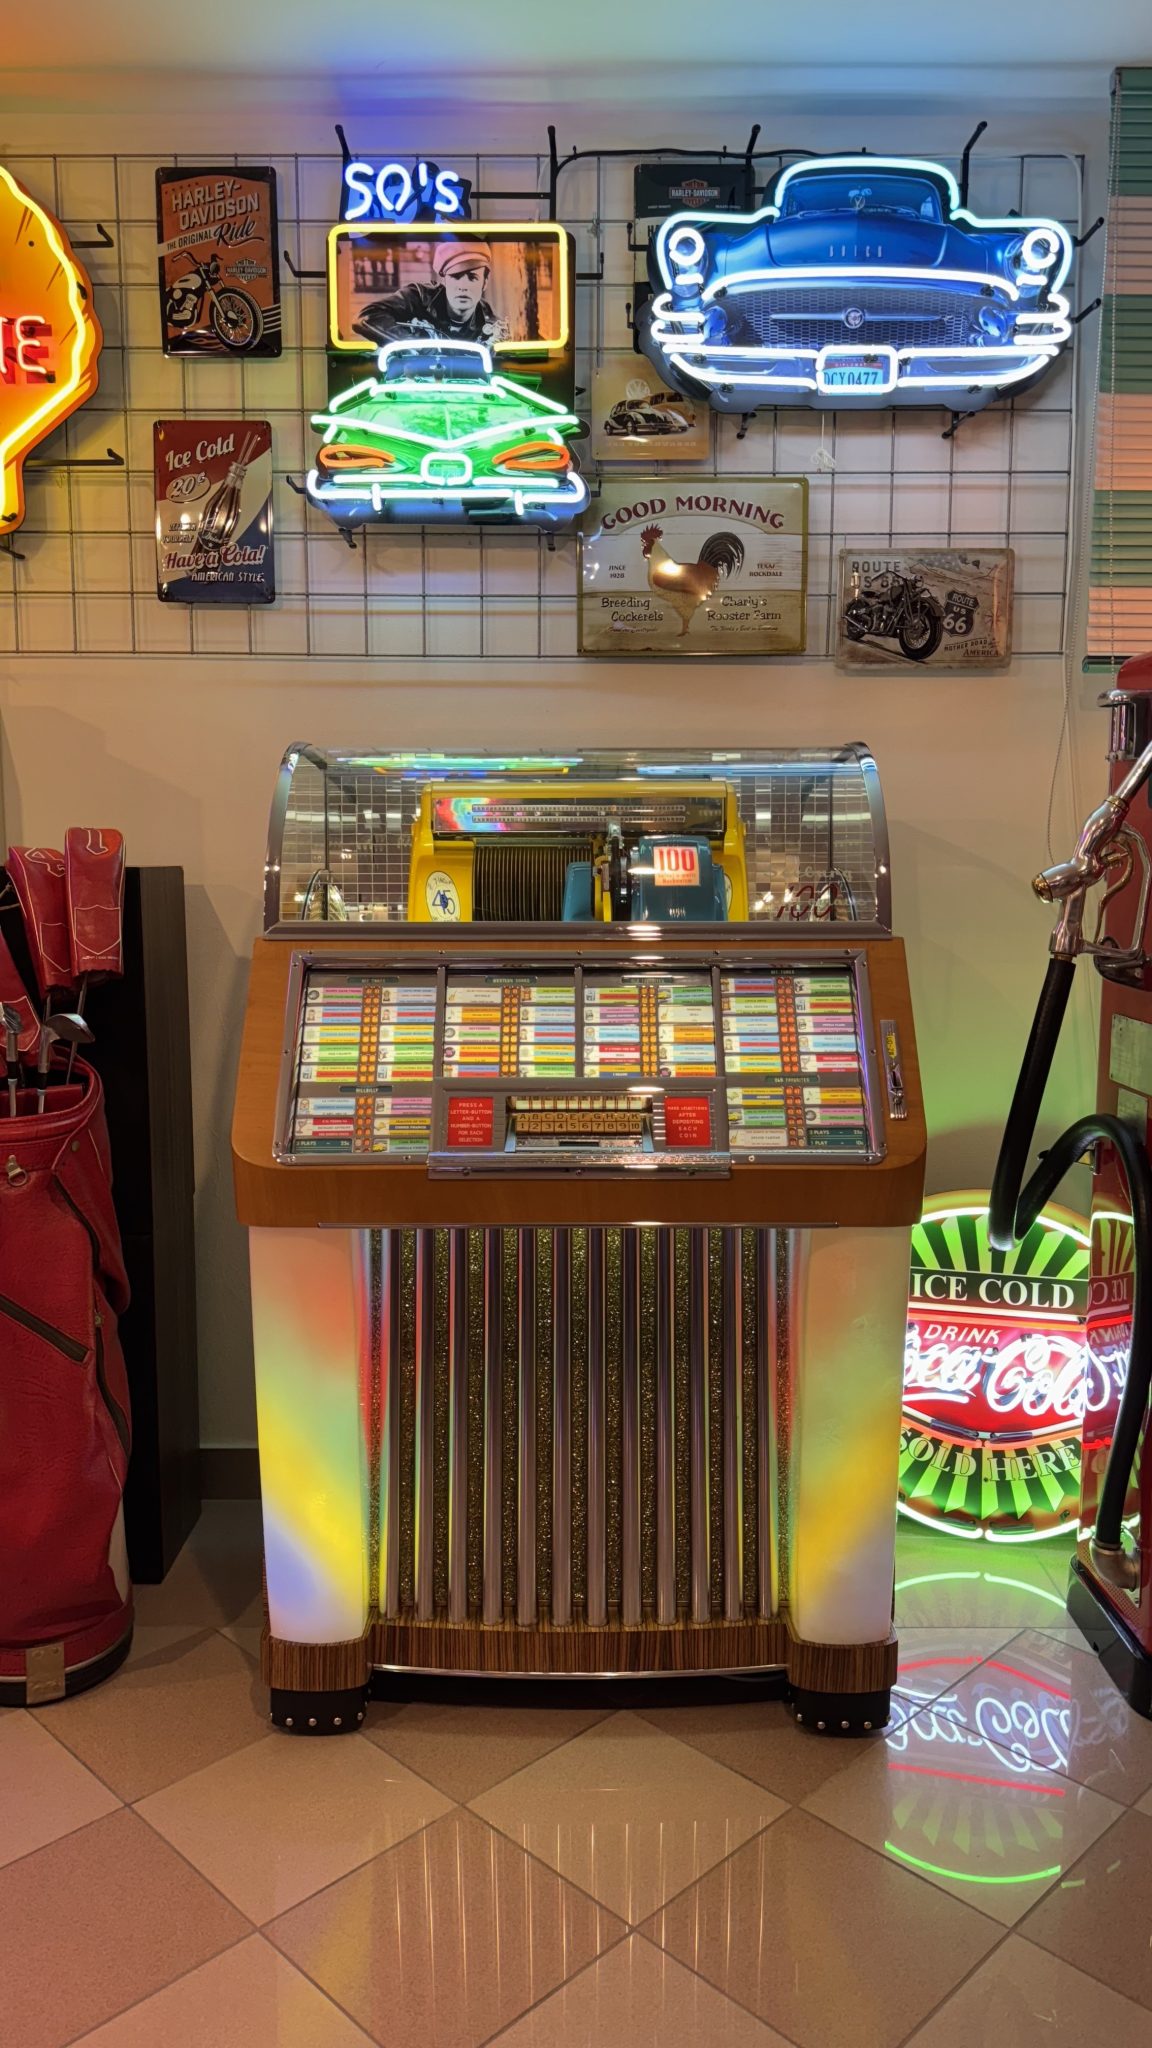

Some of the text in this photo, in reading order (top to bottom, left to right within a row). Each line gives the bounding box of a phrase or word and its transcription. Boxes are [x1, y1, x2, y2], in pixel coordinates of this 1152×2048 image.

[172, 179, 242, 212] HARLEY-
[180, 192, 260, 231] DAVIDSON
[167, 216, 261, 251] THE ORIGINAL Ride
[165, 433, 235, 472] Ice Cold
[601, 495, 785, 530] GOOD MORNING
[165, 543, 266, 571] Have a Cola!
[852, 560, 901, 573] ROUTE
[191, 571, 235, 582] AMERICAN
[601, 596, 650, 610] Breeding
[722, 596, 768, 609] Charly's
[952, 593, 975, 607] ROUTE
[953, 606, 967, 615] US
[611, 611, 664, 622] Cockerels
[707, 610, 782, 621] Rooster Farm
[942, 613, 967, 633] 66
[963, 648, 1000, 657] AMERICA
[658, 848, 695, 872] 100
[432, 889, 456, 915] 45
[911, 1272, 968, 1301] ICE
[978, 1278, 1075, 1310] COLD
[923, 1323, 1003, 1345] DRINK
[900, 1426, 1081, 1482] SOLD HERE
